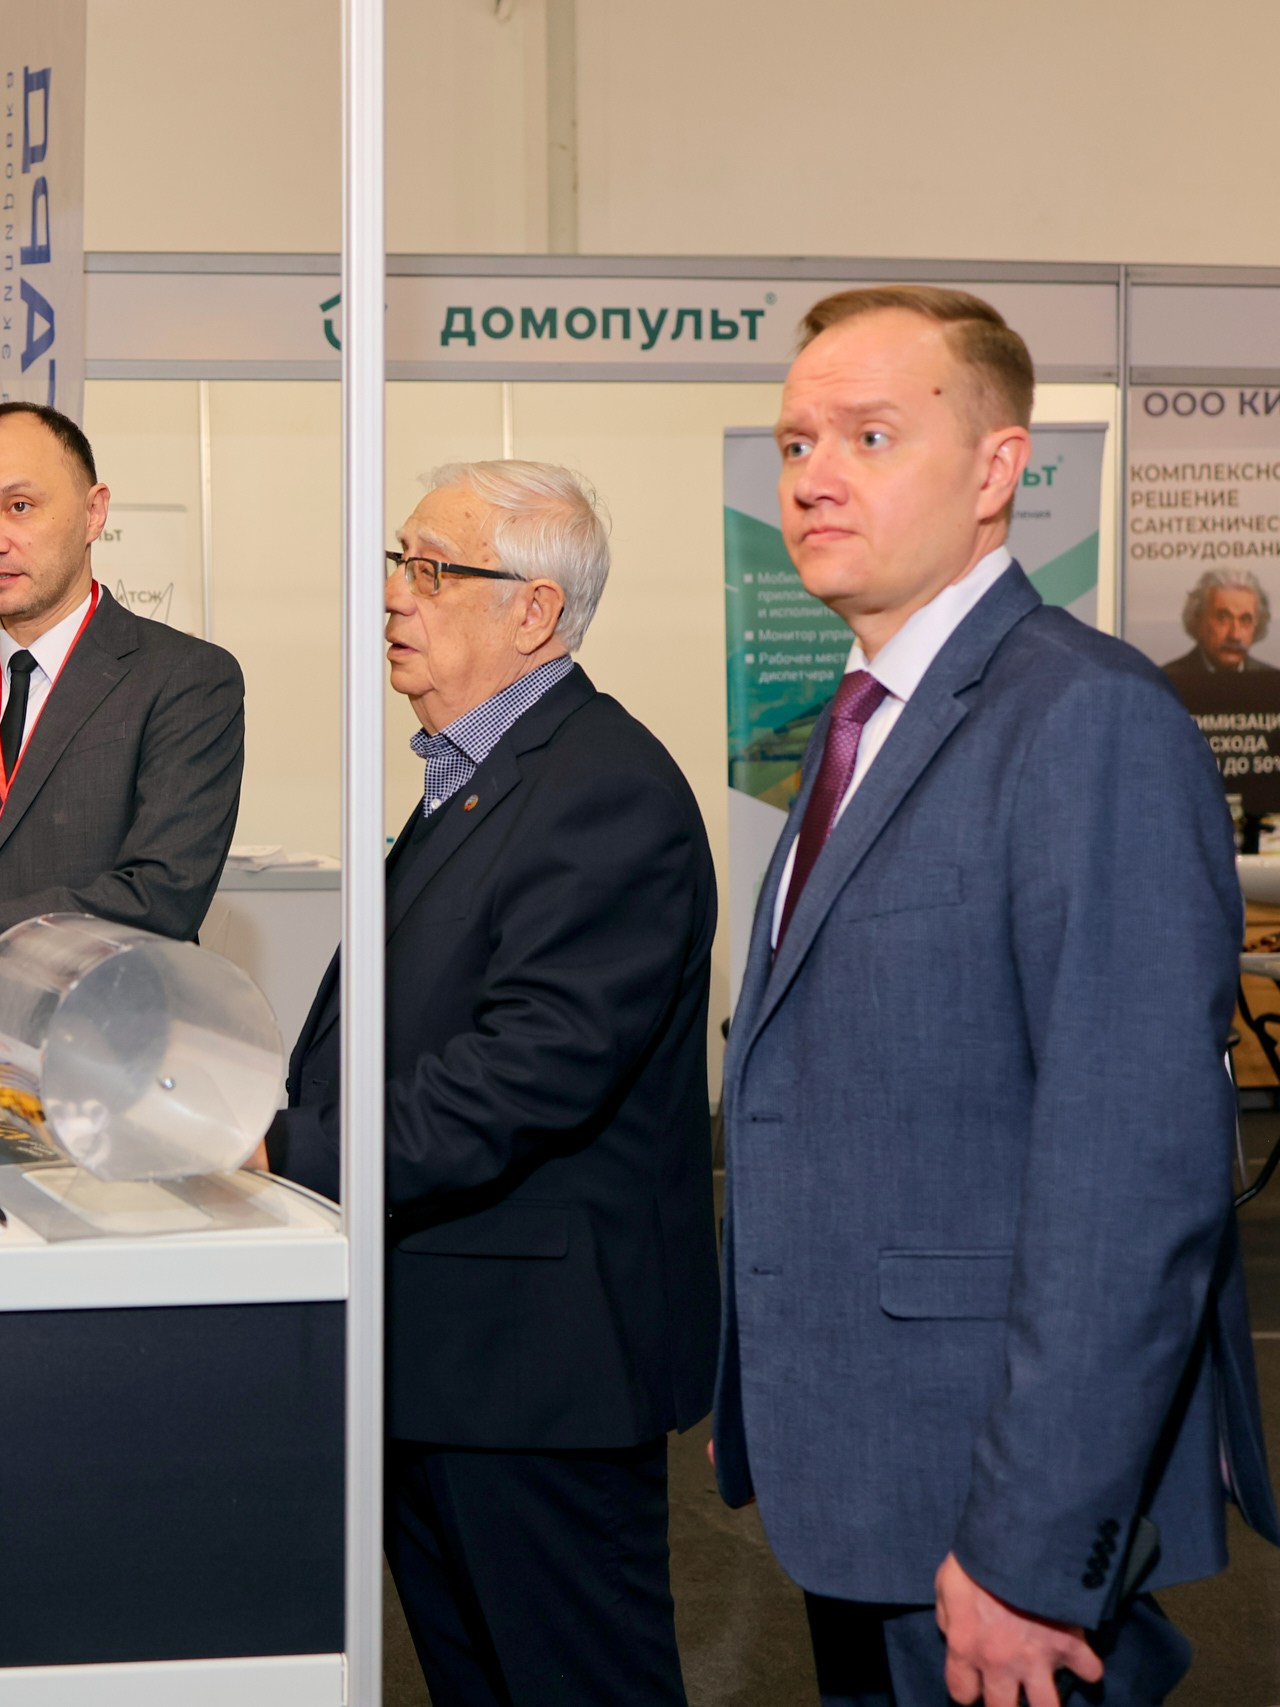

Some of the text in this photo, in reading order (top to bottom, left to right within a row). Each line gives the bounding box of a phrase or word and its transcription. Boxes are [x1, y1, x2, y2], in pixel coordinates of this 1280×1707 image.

[1144, 391, 1225, 418] ООО
[1130, 489, 1240, 509] РЕШЕНИЕ
[758, 630, 817, 643] Монитор
[759, 652, 812, 664] Рабочее
[759, 670, 834, 683] диспетчера
[1223, 756, 1249, 777] ДО
